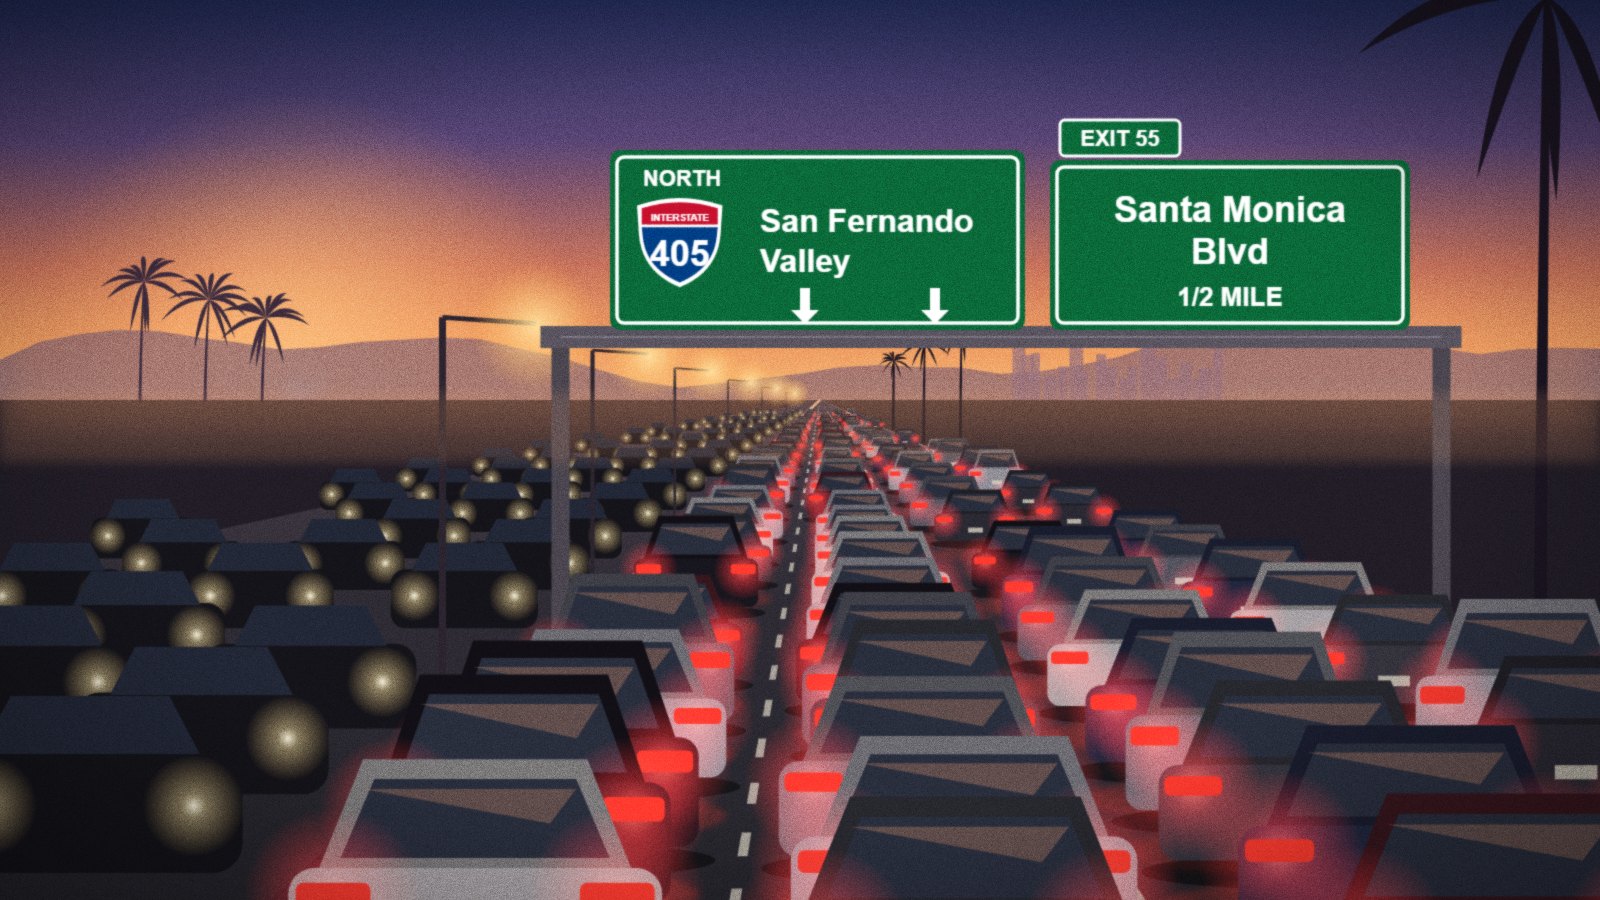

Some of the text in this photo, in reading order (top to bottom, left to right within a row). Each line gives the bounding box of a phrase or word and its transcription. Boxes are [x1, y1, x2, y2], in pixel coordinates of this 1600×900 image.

[1081, 129, 1160, 148] EXIT 55
[643, 169, 721, 187] NORTH
[650, 213, 709, 222] INTERSTATE
[760, 208, 974, 233] San Fernando
[1115, 195, 1345, 223] Santa Monica
[650, 238, 711, 268] 405
[760, 248, 850, 279] Valley
[1192, 237, 1268, 265] Blvd
[1178, 286, 1283, 307] 1/2 MILE
